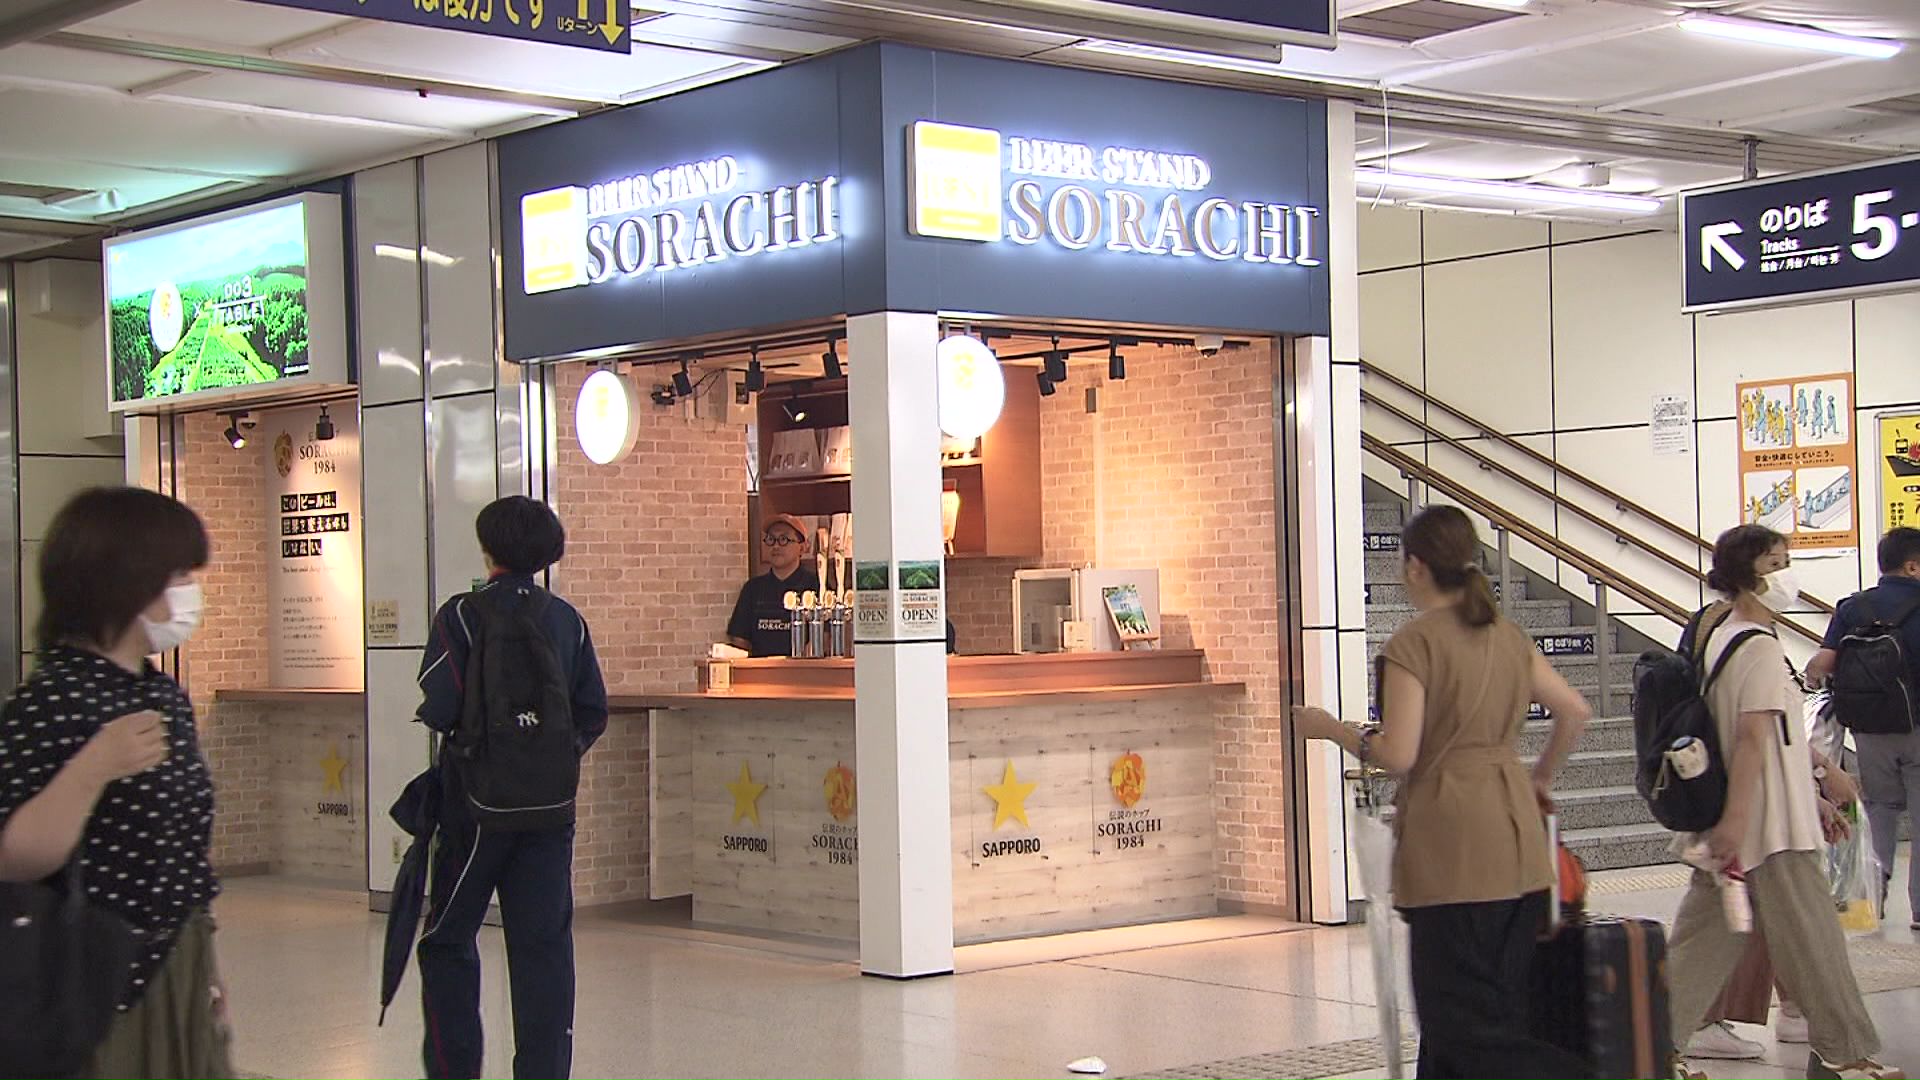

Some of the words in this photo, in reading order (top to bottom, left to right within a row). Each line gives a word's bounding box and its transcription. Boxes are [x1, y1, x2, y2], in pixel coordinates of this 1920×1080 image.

[1008, 136, 1098, 180] BEER
[1102, 146, 1212, 191] STAND
[588, 172, 650, 218] BEER
[652, 155, 738, 205] STAND
[1007, 180, 1321, 266] SORACHI
[1760, 198, 1830, 233] のりば
[586, 175, 840, 284] SORACHI
[1760, 237, 1799, 255] Tracks
[314, 460, 336, 475] 1984
[859, 610, 888, 622] OPEN!
[902, 609, 938, 621] OPEN!
[1097, 819, 1162, 837] SORACHI
[724, 834, 768, 853] SAPPORO
[812, 834, 857, 850] SORAC
[982, 837, 1042, 858] SAPPORO
[1116, 835, 1145, 851] 1984
[828, 851, 853, 865] 1984
